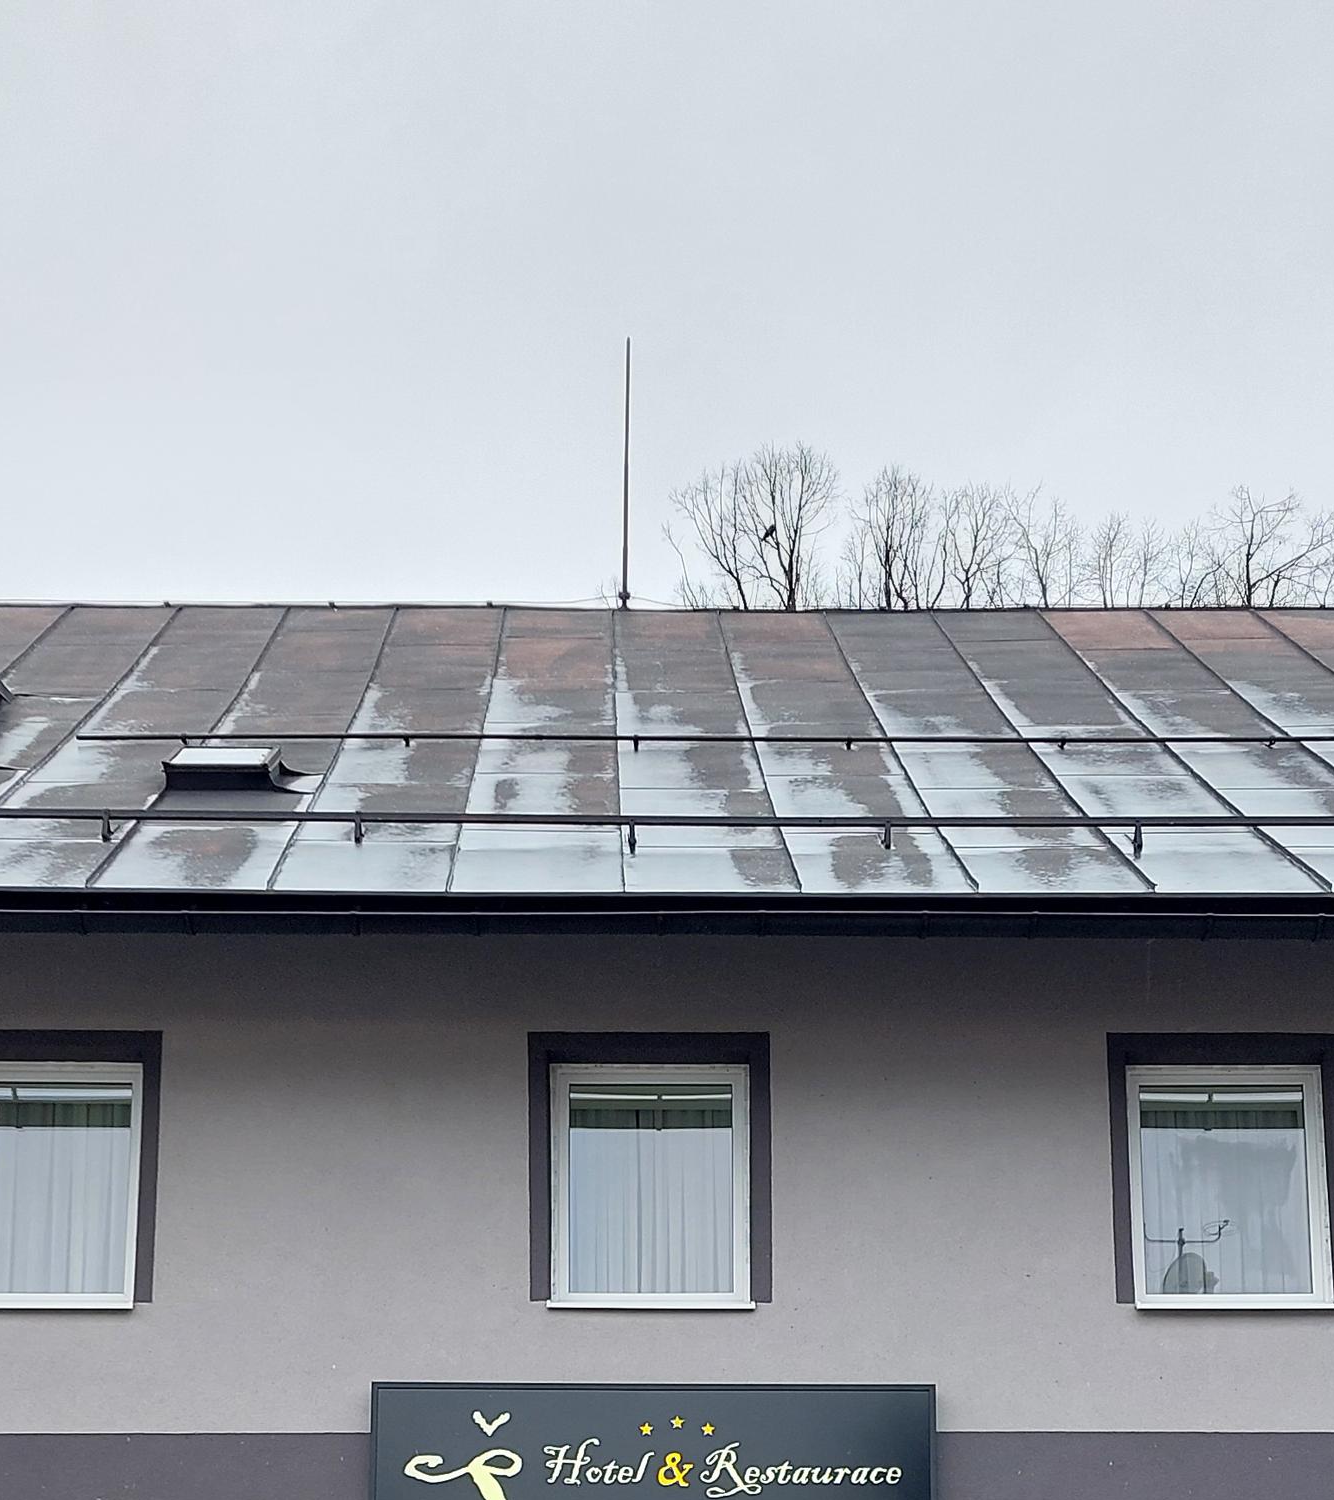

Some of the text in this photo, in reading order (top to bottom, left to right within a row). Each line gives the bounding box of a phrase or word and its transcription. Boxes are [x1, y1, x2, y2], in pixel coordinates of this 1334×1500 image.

[542, 1437, 903, 1499] Hotel & Restaurace
